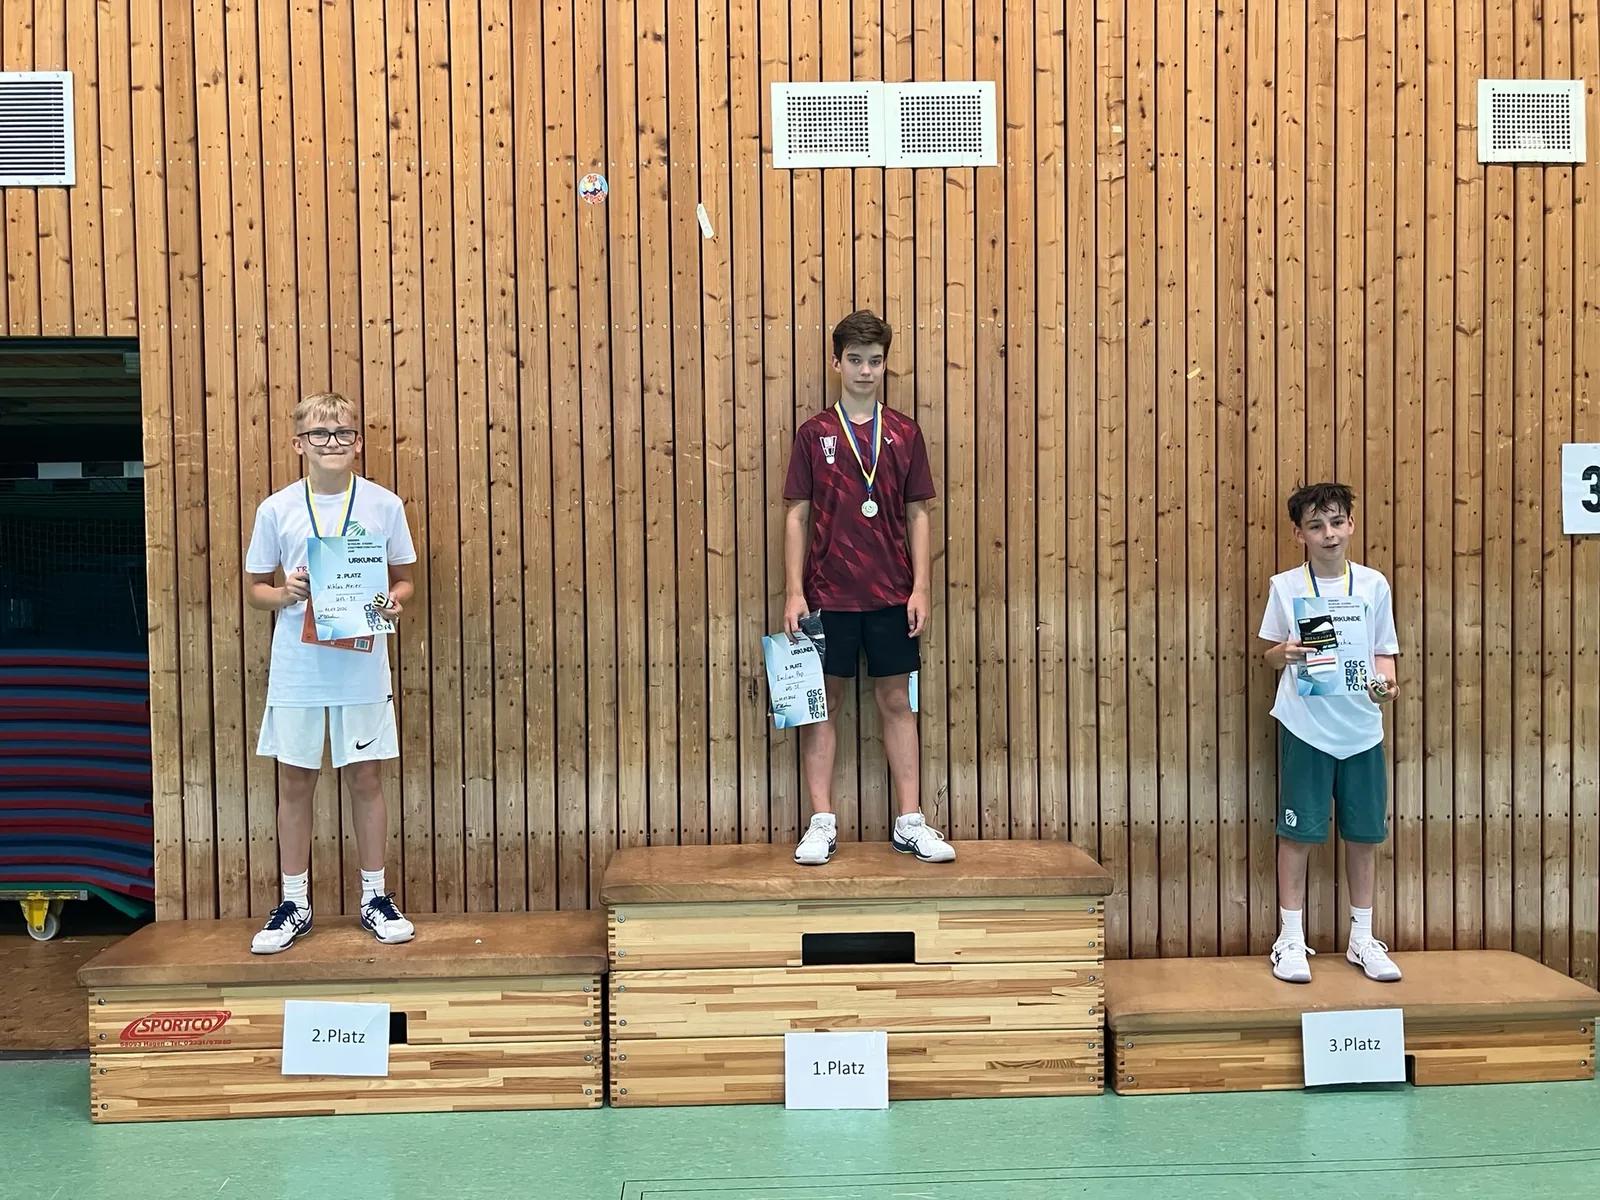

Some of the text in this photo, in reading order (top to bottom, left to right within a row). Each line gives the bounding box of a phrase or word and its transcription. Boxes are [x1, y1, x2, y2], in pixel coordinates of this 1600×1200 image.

[1581, 465, 1600, 513] 3
[791, 646, 815, 656] URKUNDE
[136, 1017, 213, 1033] SPORTCO
[312, 1028, 365, 1043] 2.Platz
[1329, 1037, 1381, 1052] 3.Platz
[813, 1060, 865, 1075] 1.Platz
